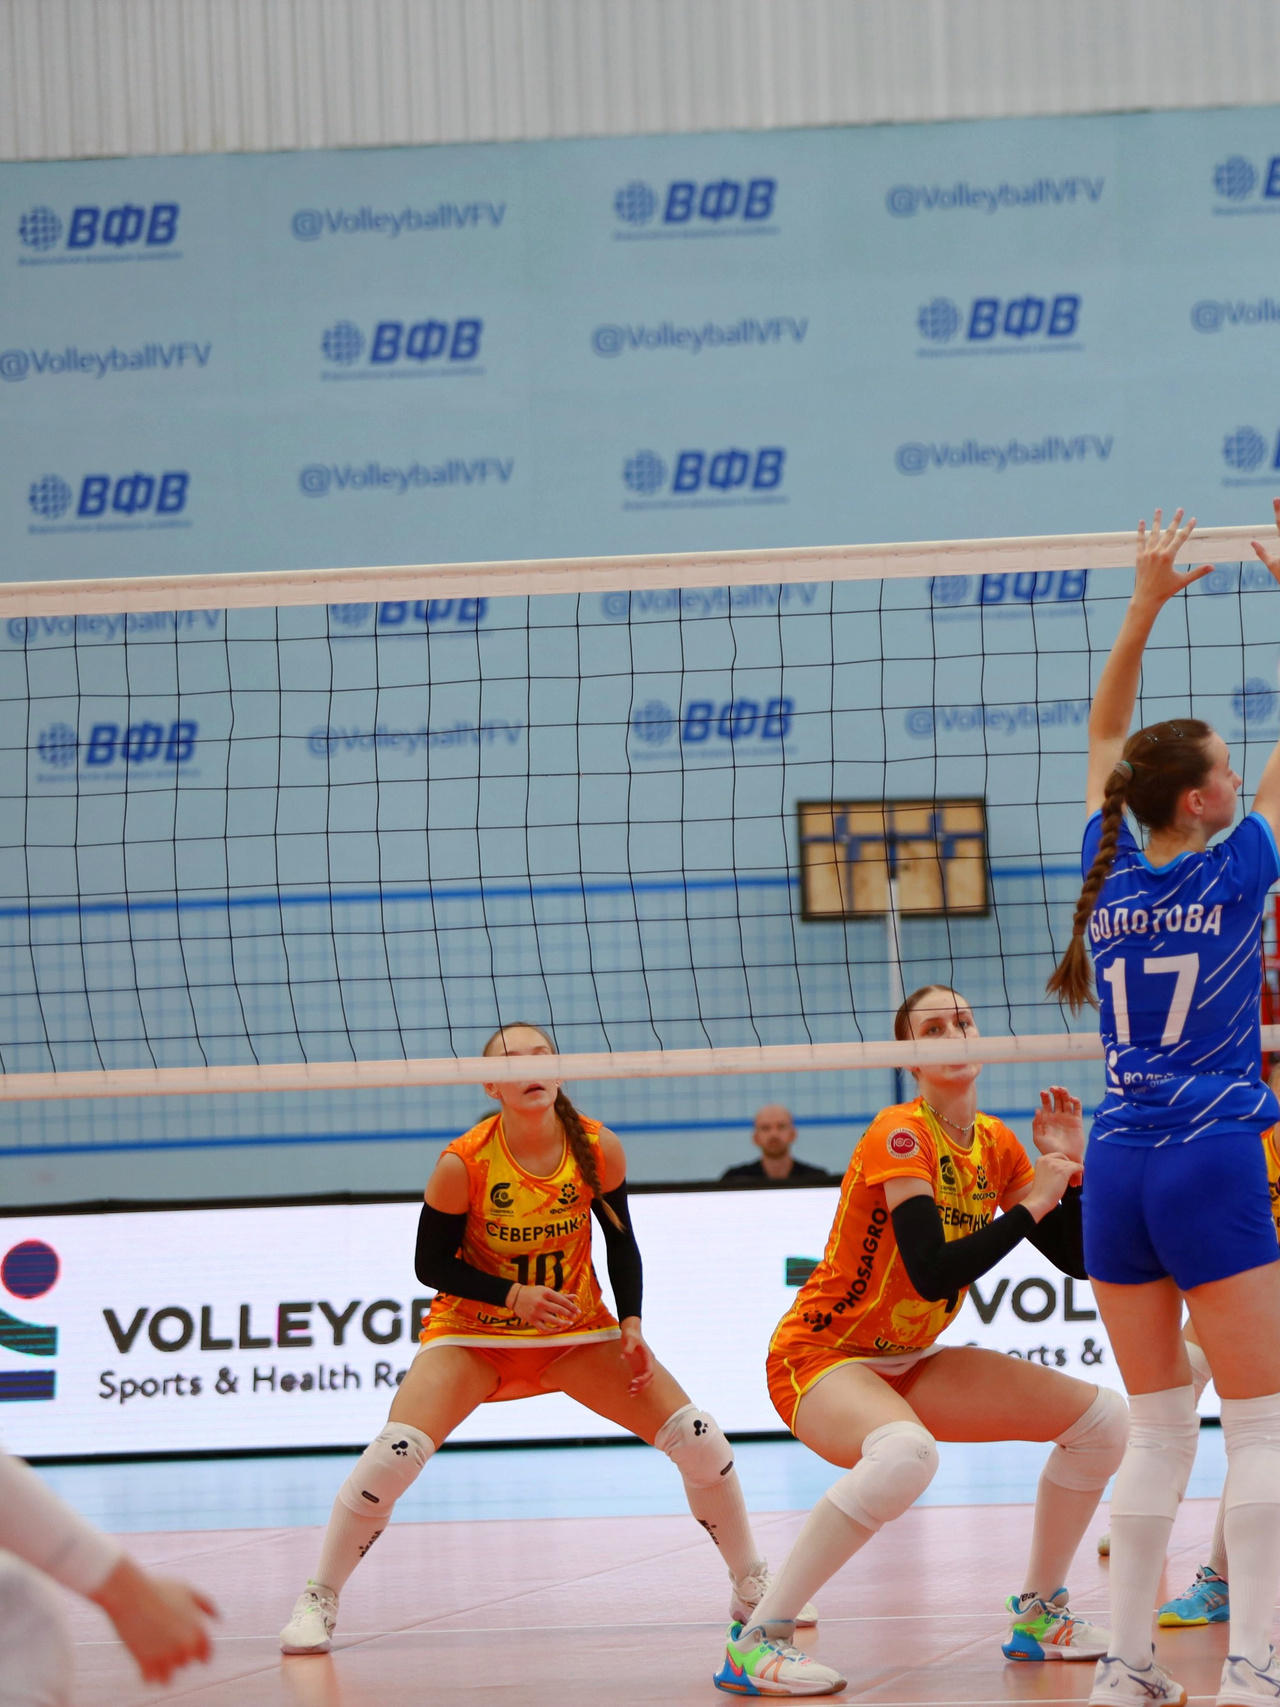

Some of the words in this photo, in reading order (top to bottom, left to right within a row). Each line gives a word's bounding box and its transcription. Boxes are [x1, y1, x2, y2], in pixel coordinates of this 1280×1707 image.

[663, 178, 776, 224] ВФВ
[885, 178, 1104, 218] @VolleyballVFV
[67, 203, 179, 249] ВФВ
[290, 203, 506, 242] @VolleyballVFV
[369, 318, 483, 364] ВФВ
[591, 318, 809, 358] @VolleyballVFV
[967, 295, 1080, 341] ВФВ
[0, 342, 212, 382] @VolleyballVFV
[298, 459, 514, 498] @VolleyballVFV
[672, 447, 785, 494] ВФВ
[895, 436, 1114, 476] @VolleyballVFV
[77, 471, 189, 518] ВФВ
[85, 720, 198, 766] ВФВ
[680, 697, 794, 744] ВФВ
[1090, 904, 1223, 943] БОЛОТОВА
[1103, 952, 1200, 1047] 17
[510, 1250, 565, 1292] 10
[832, 1207, 888, 1315] PHOSAGRO
[103, 1299, 432, 1354] VOLLEYG
[1081, 1338, 1102, 1366] &
[99, 1369, 203, 1404] Sports
[215, 1367, 238, 1395] &
[253, 1364, 361, 1393] Health
